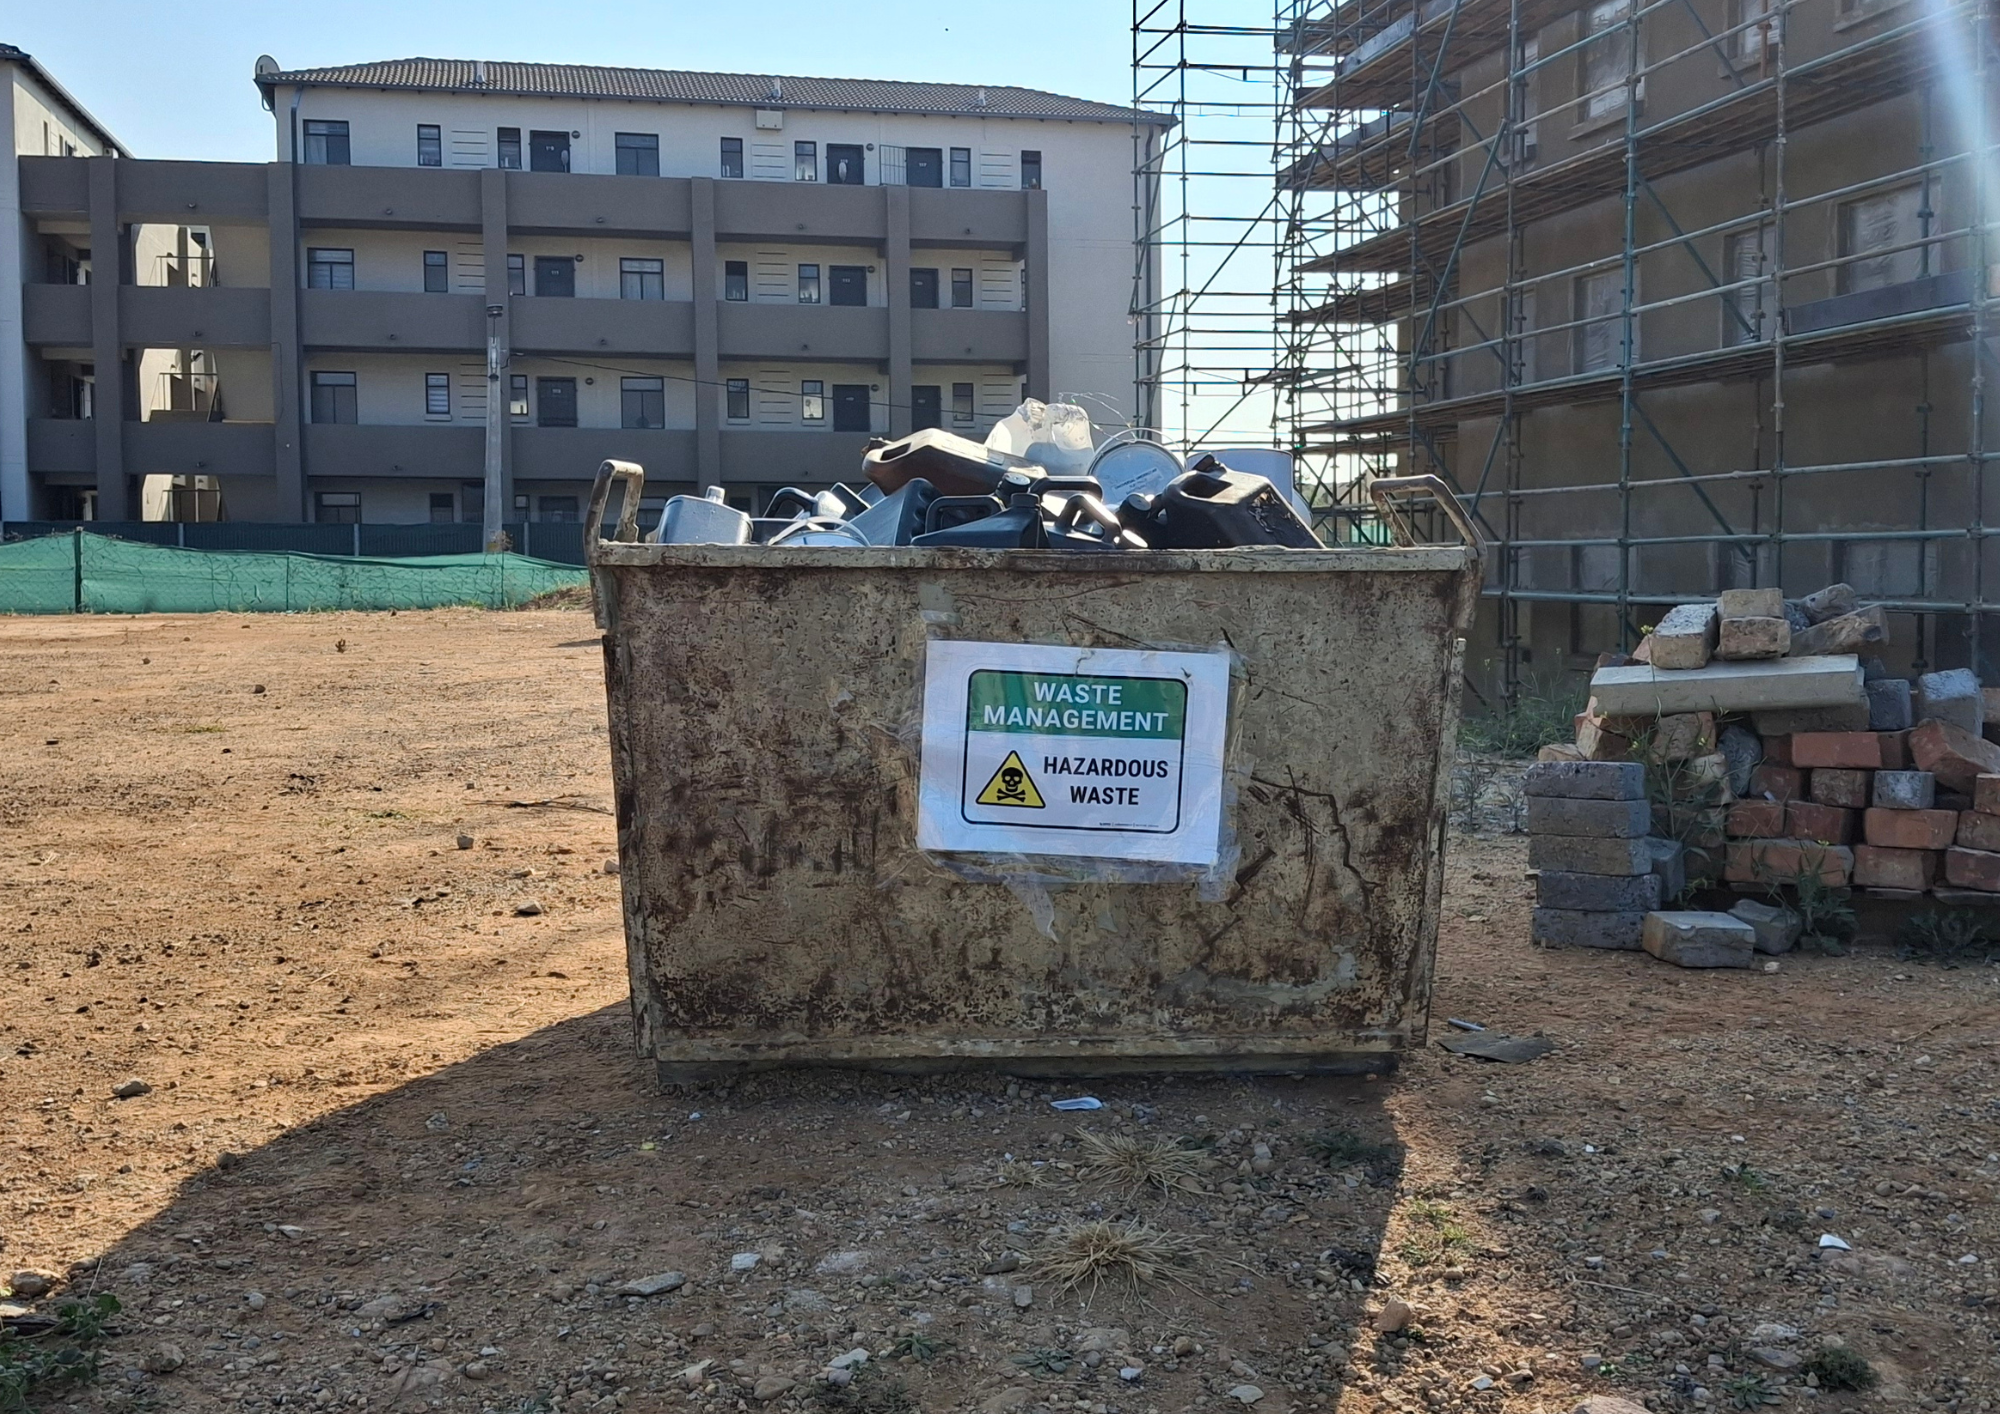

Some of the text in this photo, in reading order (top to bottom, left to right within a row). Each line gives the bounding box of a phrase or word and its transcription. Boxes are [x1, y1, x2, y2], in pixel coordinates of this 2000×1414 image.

[1034, 682, 1123, 705] WASTE
[983, 705, 1169, 732] MANAGEMENT
[1043, 756, 1169, 778] HAZARDOUS
[1070, 785, 1140, 806] WASTE
